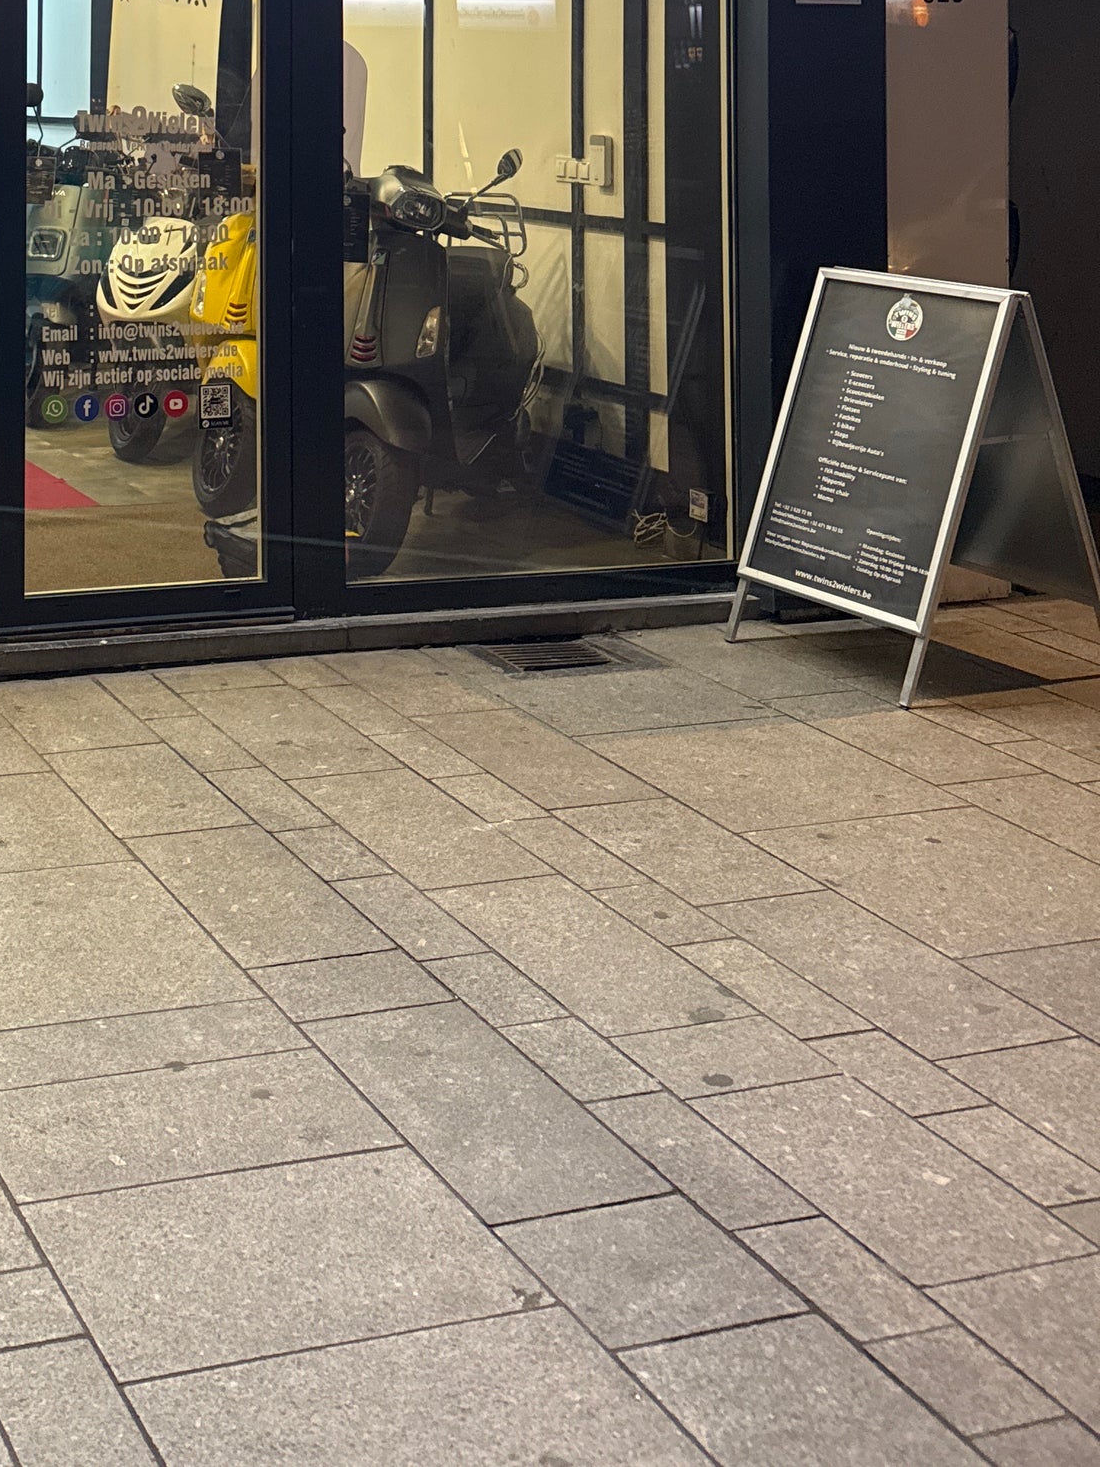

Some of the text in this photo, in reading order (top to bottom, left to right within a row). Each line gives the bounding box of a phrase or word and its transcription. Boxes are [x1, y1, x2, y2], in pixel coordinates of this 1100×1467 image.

[87, 171, 116, 190] Ma
[133, 170, 211, 190] Gesloten
[82, 197, 114, 223] Vrij
[133, 197, 184, 217] 10:00
[201, 196, 252, 216] 18:00
[111, 225, 161, 245] 10:00
[121, 254, 145, 277] Op
[150, 253, 229, 276] afspraak
[42, 324, 78, 342] Email
[42, 349, 71, 365] Web
[98, 343, 238, 363] www.twins2wielers.be
[880, 358, 909, 370] onderhoud
[924, 357, 947, 369] verkoop
[42, 363, 244, 390] Wij zijn actief op sociale media
[795, 569, 872, 600] www.twins2wielers.be
